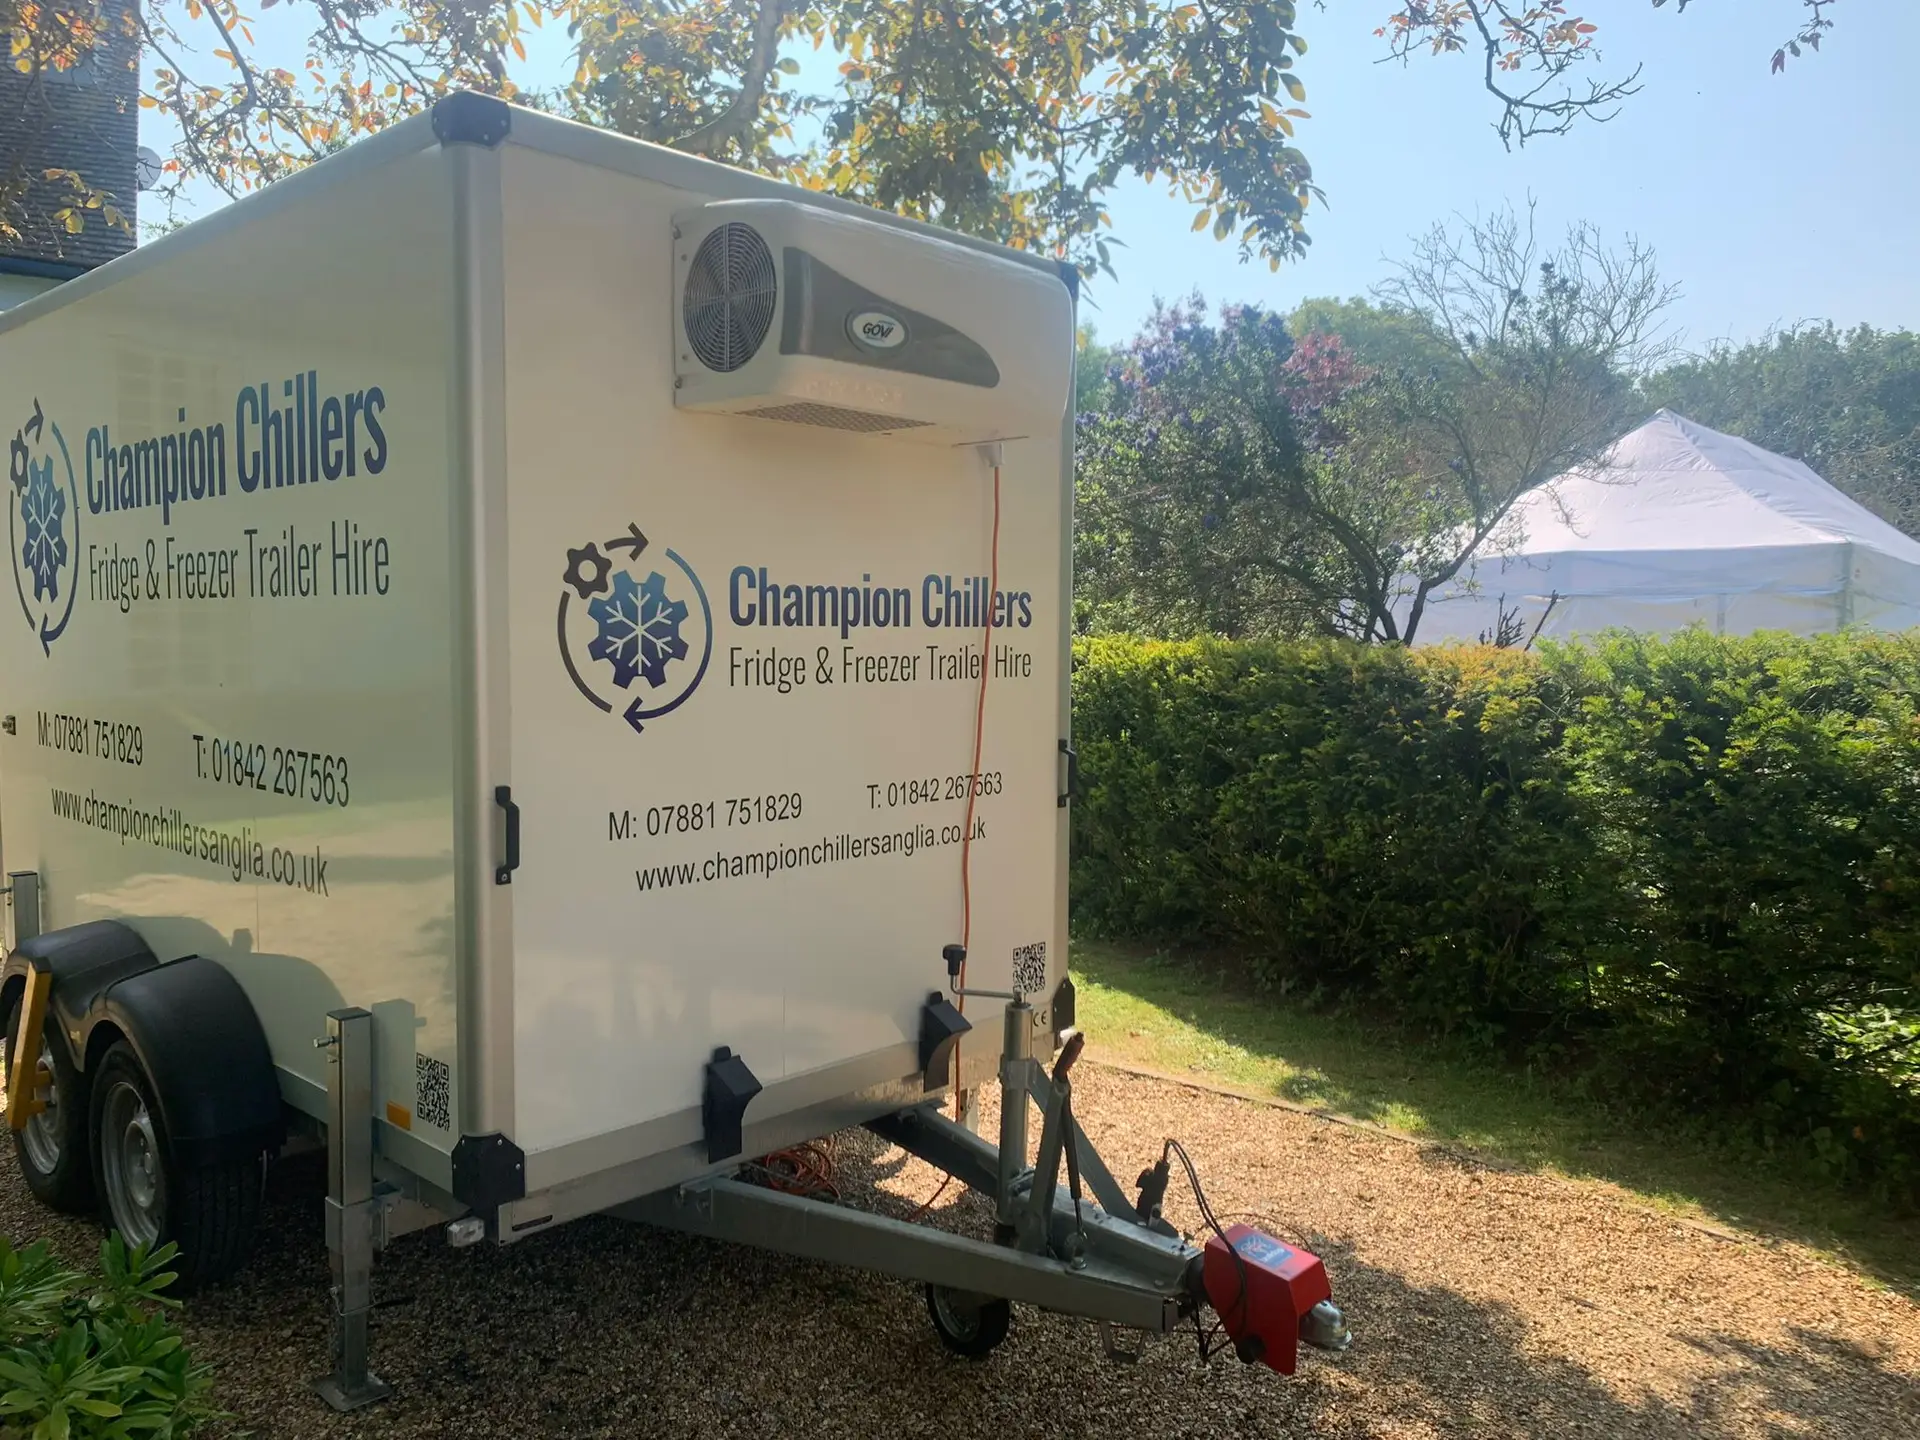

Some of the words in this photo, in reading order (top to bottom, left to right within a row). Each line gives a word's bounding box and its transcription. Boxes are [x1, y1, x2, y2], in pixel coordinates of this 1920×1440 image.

[86, 407, 227, 525] Champion
[235, 370, 388, 493] Chillers
[89, 544, 140, 613] Fridge
[145, 538, 160, 600] &
[166, 536, 239, 600] Freezer
[244, 525, 322, 598] Trailer
[331, 519, 390, 596] Hire
[729, 565, 911, 639] Champion
[922, 574, 1032, 628] Chillers
[730, 647, 806, 693] Fridge
[815, 646, 833, 684] &
[843, 646, 920, 683] Freezer
[995, 645, 1032, 678] Hire
[37, 711, 52, 747] M:
[54, 713, 89, 755] 07881
[94, 720, 143, 766] 751829
[192, 734, 207, 778] T:
[213, 738, 267, 791] 01842
[273, 746, 349, 808] 267563
[608, 811, 637, 841] M:
[646, 803, 715, 836] 07881
[725, 792, 802, 827] 751829
[867, 784, 881, 809] T:
[887, 778, 940, 808] 01842
[945, 771, 1002, 801] 267563
[52, 788, 329, 897] www.championchillersanglia.co.uk
[636, 816, 987, 891] www.championchillersanglia.co.uk
